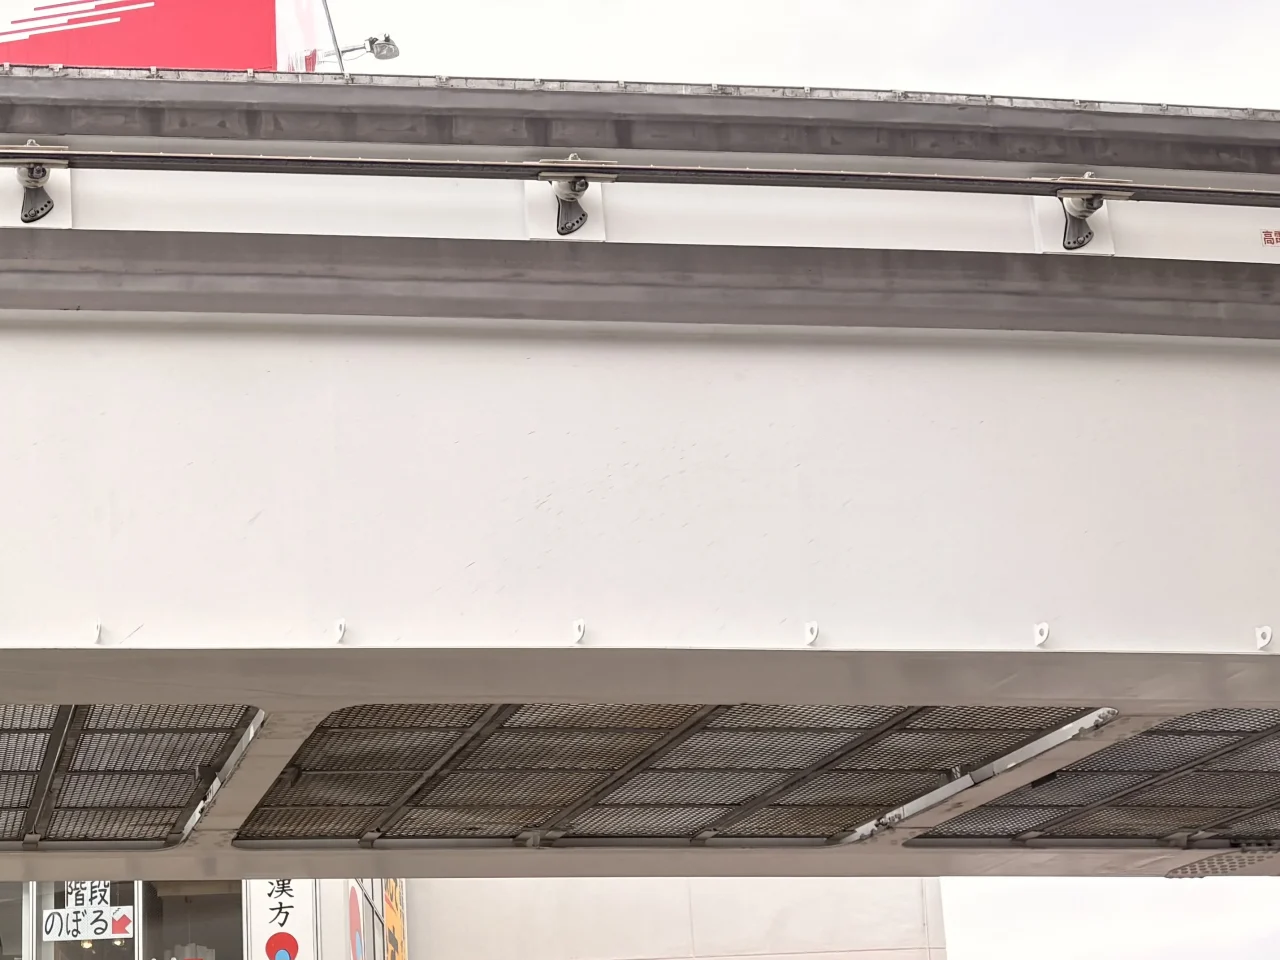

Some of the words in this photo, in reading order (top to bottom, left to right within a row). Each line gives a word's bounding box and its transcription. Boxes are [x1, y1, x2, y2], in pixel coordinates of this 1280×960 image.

[67, 881, 109, 907] 階段
[267, 880, 294, 927] 漢方
[44, 910, 108, 938] のぼる
